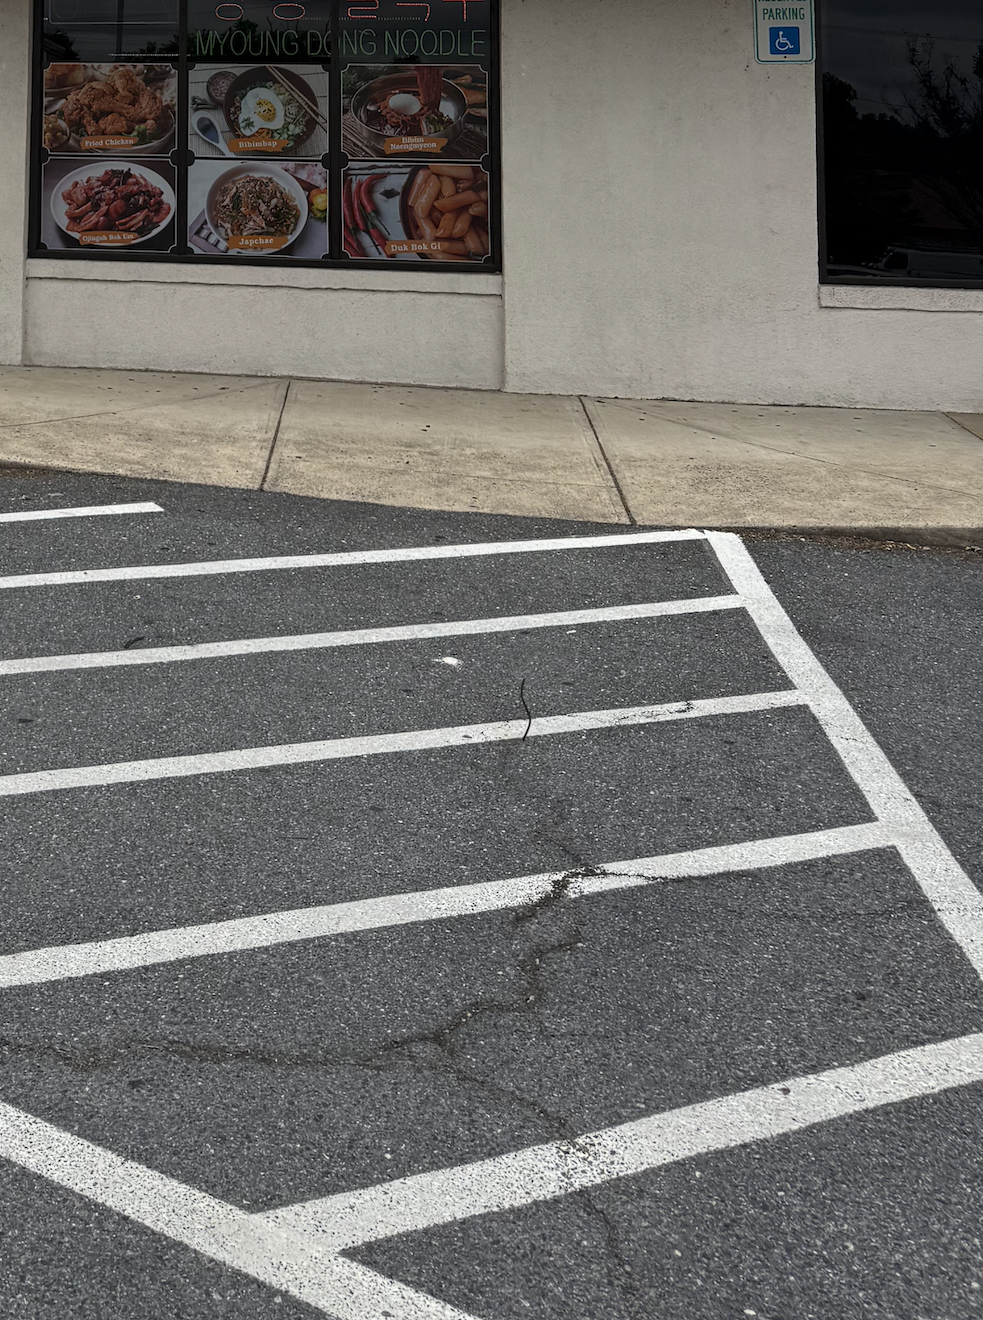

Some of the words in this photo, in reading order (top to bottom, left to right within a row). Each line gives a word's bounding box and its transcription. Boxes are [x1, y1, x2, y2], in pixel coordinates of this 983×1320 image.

[762, 7, 806, 21] PARKING
[195, 29, 300, 57] MYOUNG
[307, 28, 378, 56] DONG
[384, 29, 486, 57] NOODLE
[105, 138, 134, 146] Chicken
[239, 140, 277, 148] Bibimbap
[239, 237, 274, 247] Japchae
[390, 244, 408, 252] Duk
[411, 243, 428, 251] Bok
[430, 242, 441, 250] Gi
